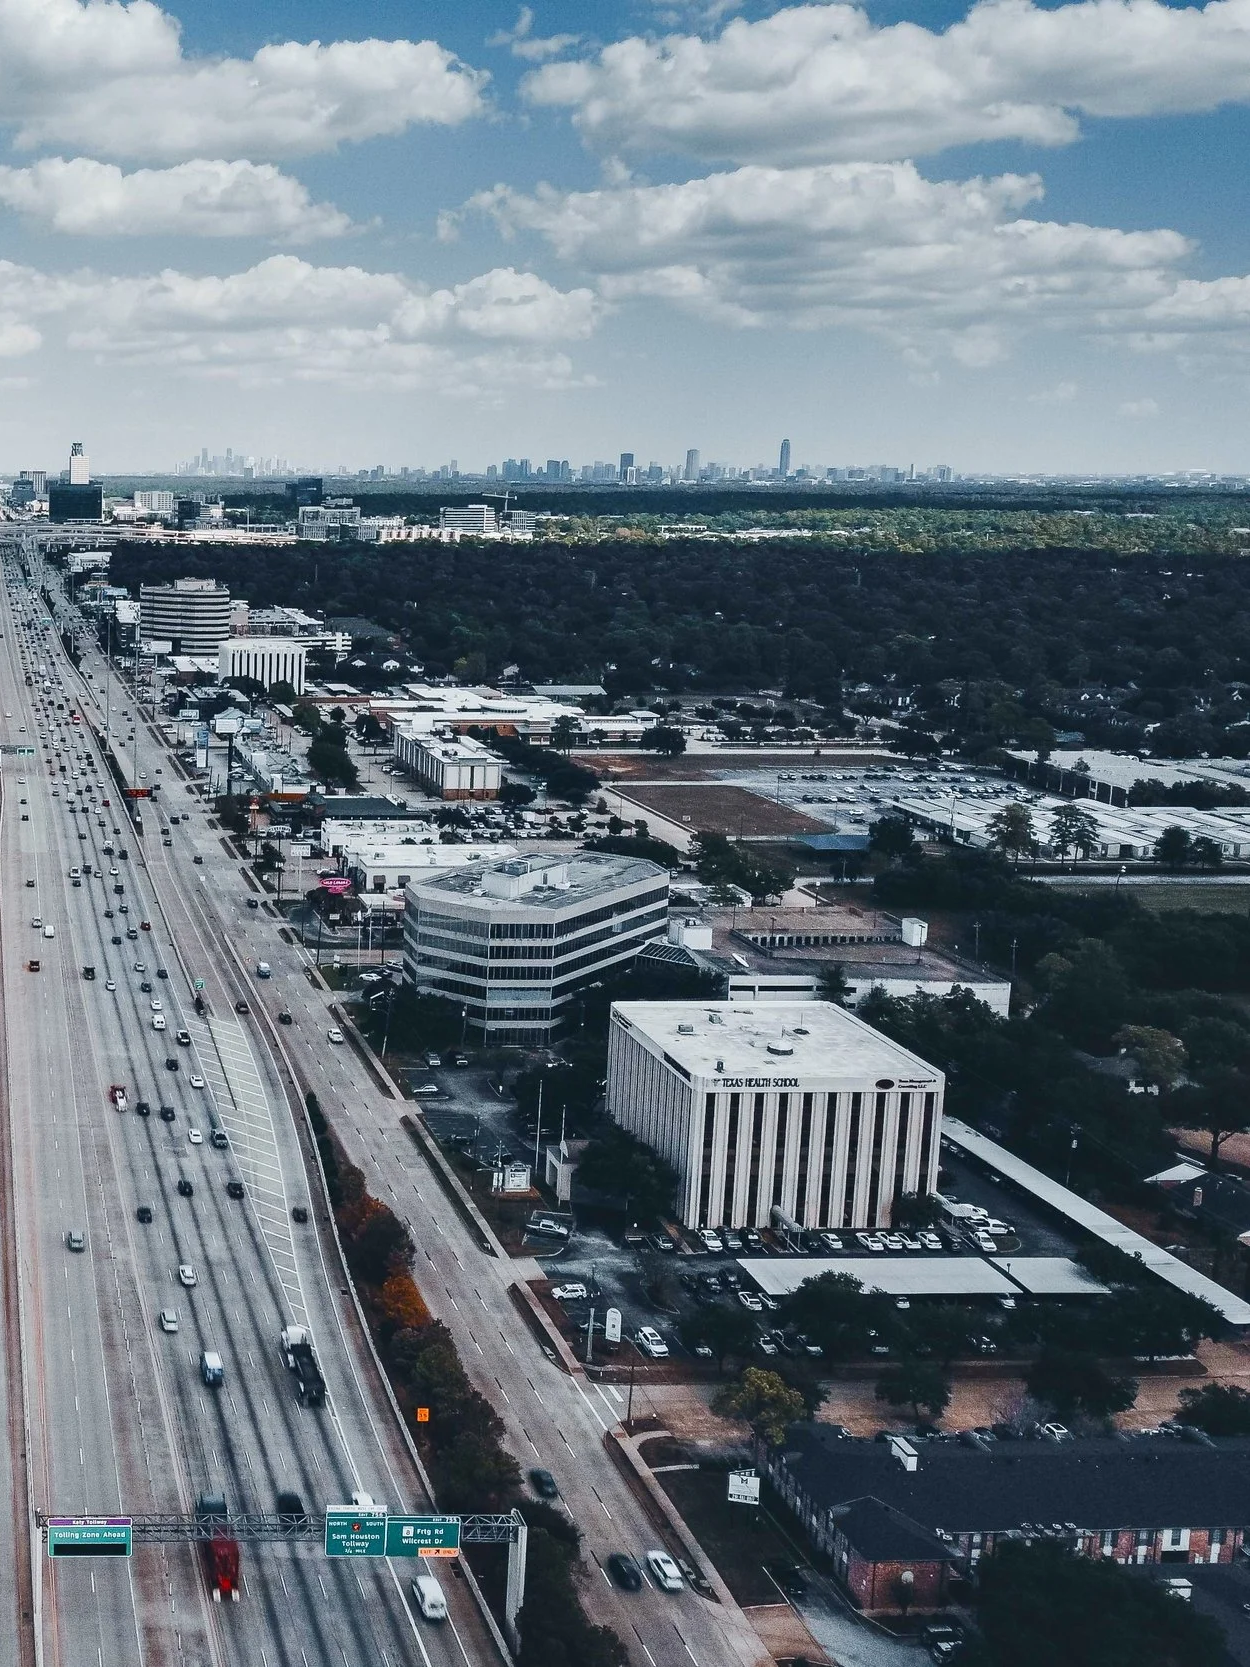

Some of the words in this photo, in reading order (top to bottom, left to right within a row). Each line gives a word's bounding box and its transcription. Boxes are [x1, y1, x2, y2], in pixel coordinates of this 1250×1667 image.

[721, 1077, 744, 1088] TEXAS
[744, 1077, 771, 1088] HEALTH
[772, 1077, 800, 1088] SCHOOL
[54, 1531, 80, 1539] Tolling
[341, 1540, 370, 1548] Tollway
